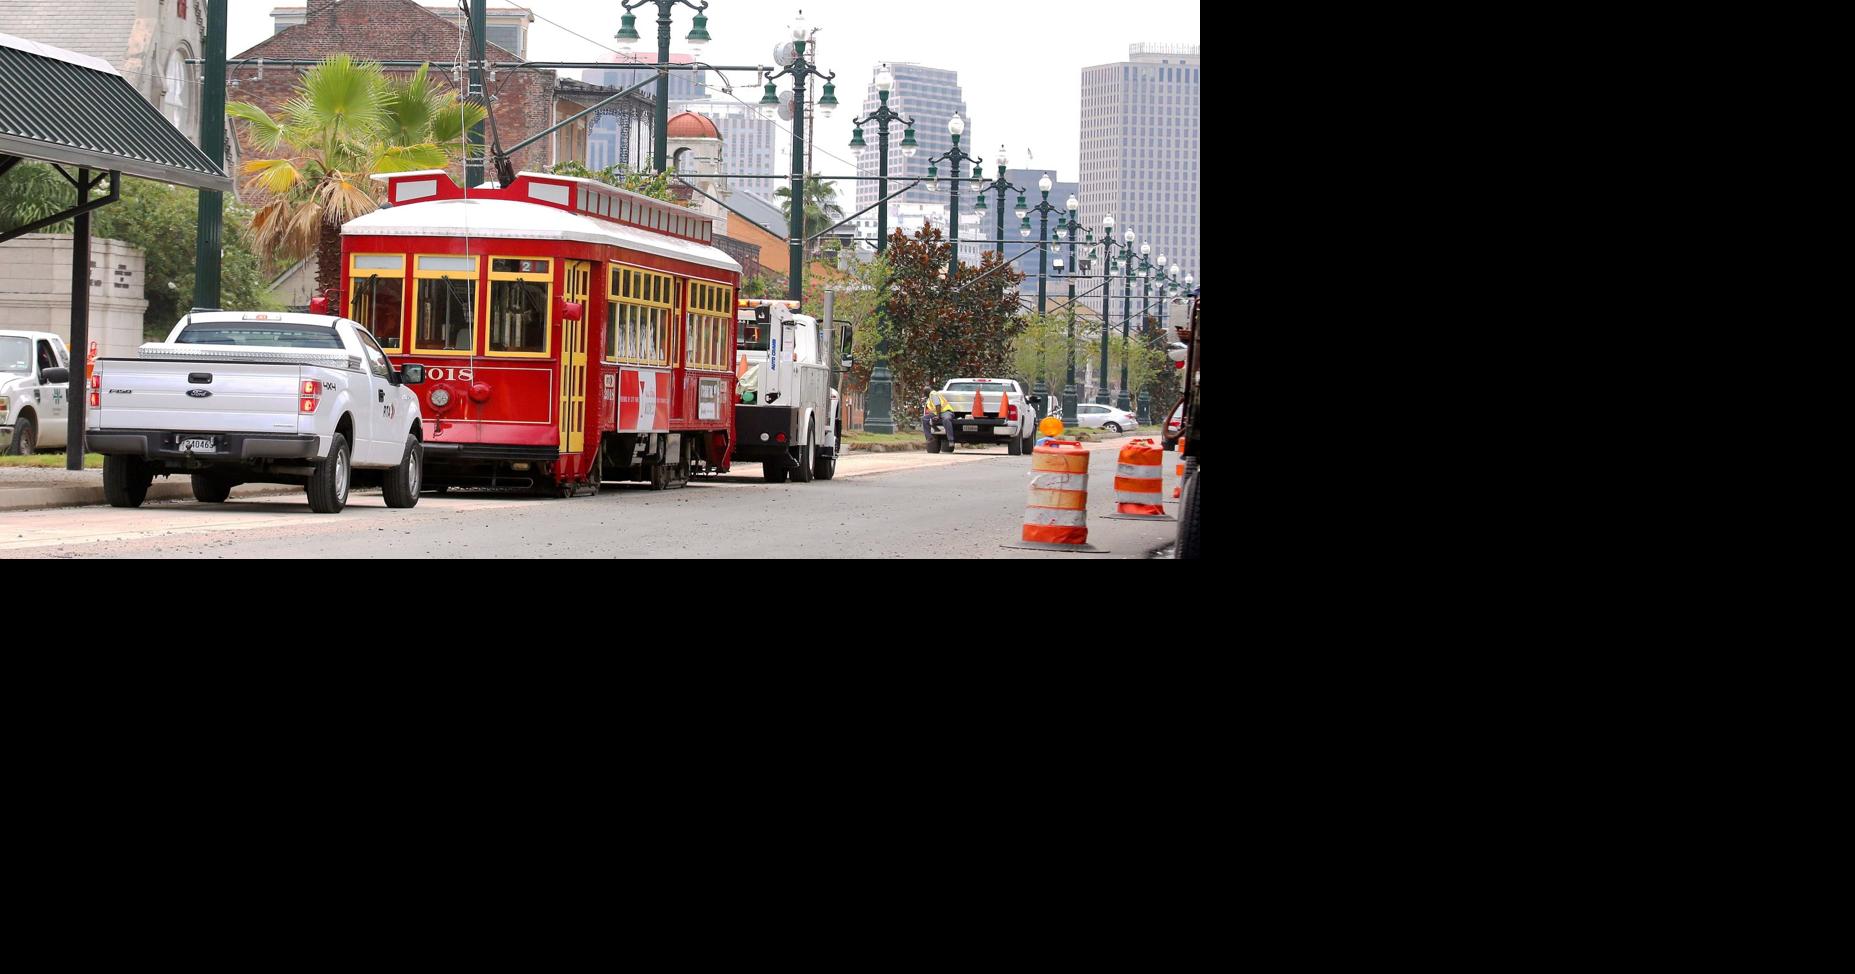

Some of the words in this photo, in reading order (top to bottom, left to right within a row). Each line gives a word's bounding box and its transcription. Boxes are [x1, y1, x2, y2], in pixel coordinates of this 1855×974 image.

[521, 261, 531, 272] 2
[424, 367, 473, 381] 018
[189, 389, 208, 398] Ford
